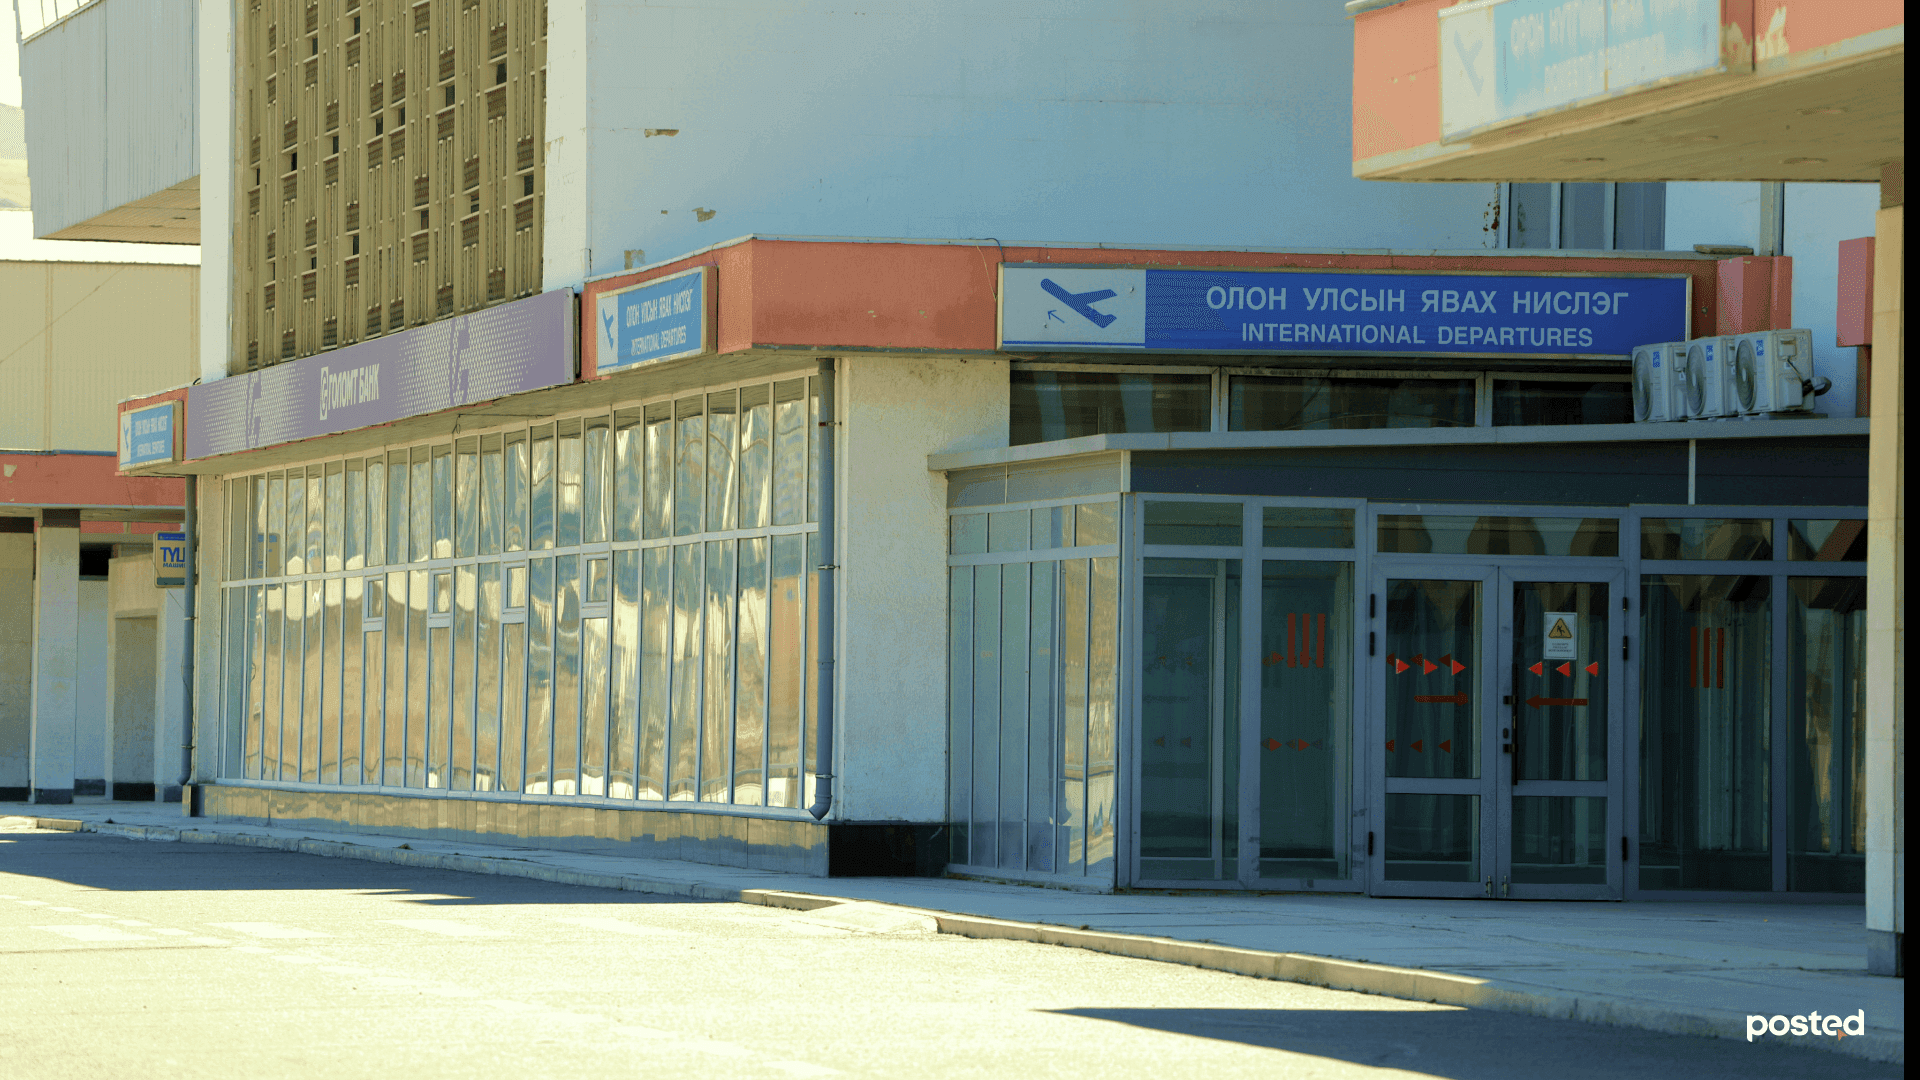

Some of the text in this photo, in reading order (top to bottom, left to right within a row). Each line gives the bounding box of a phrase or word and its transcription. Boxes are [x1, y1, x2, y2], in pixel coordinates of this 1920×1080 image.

[1206, 286, 1629, 315] ОЛОН УЛСЫН ЯВАХ НИСЛЭГ
[1242, 322, 1593, 347] INTERNATIONAL DEPARTURES
[328, 363, 380, 410] ГОЛОМТ БАНК
